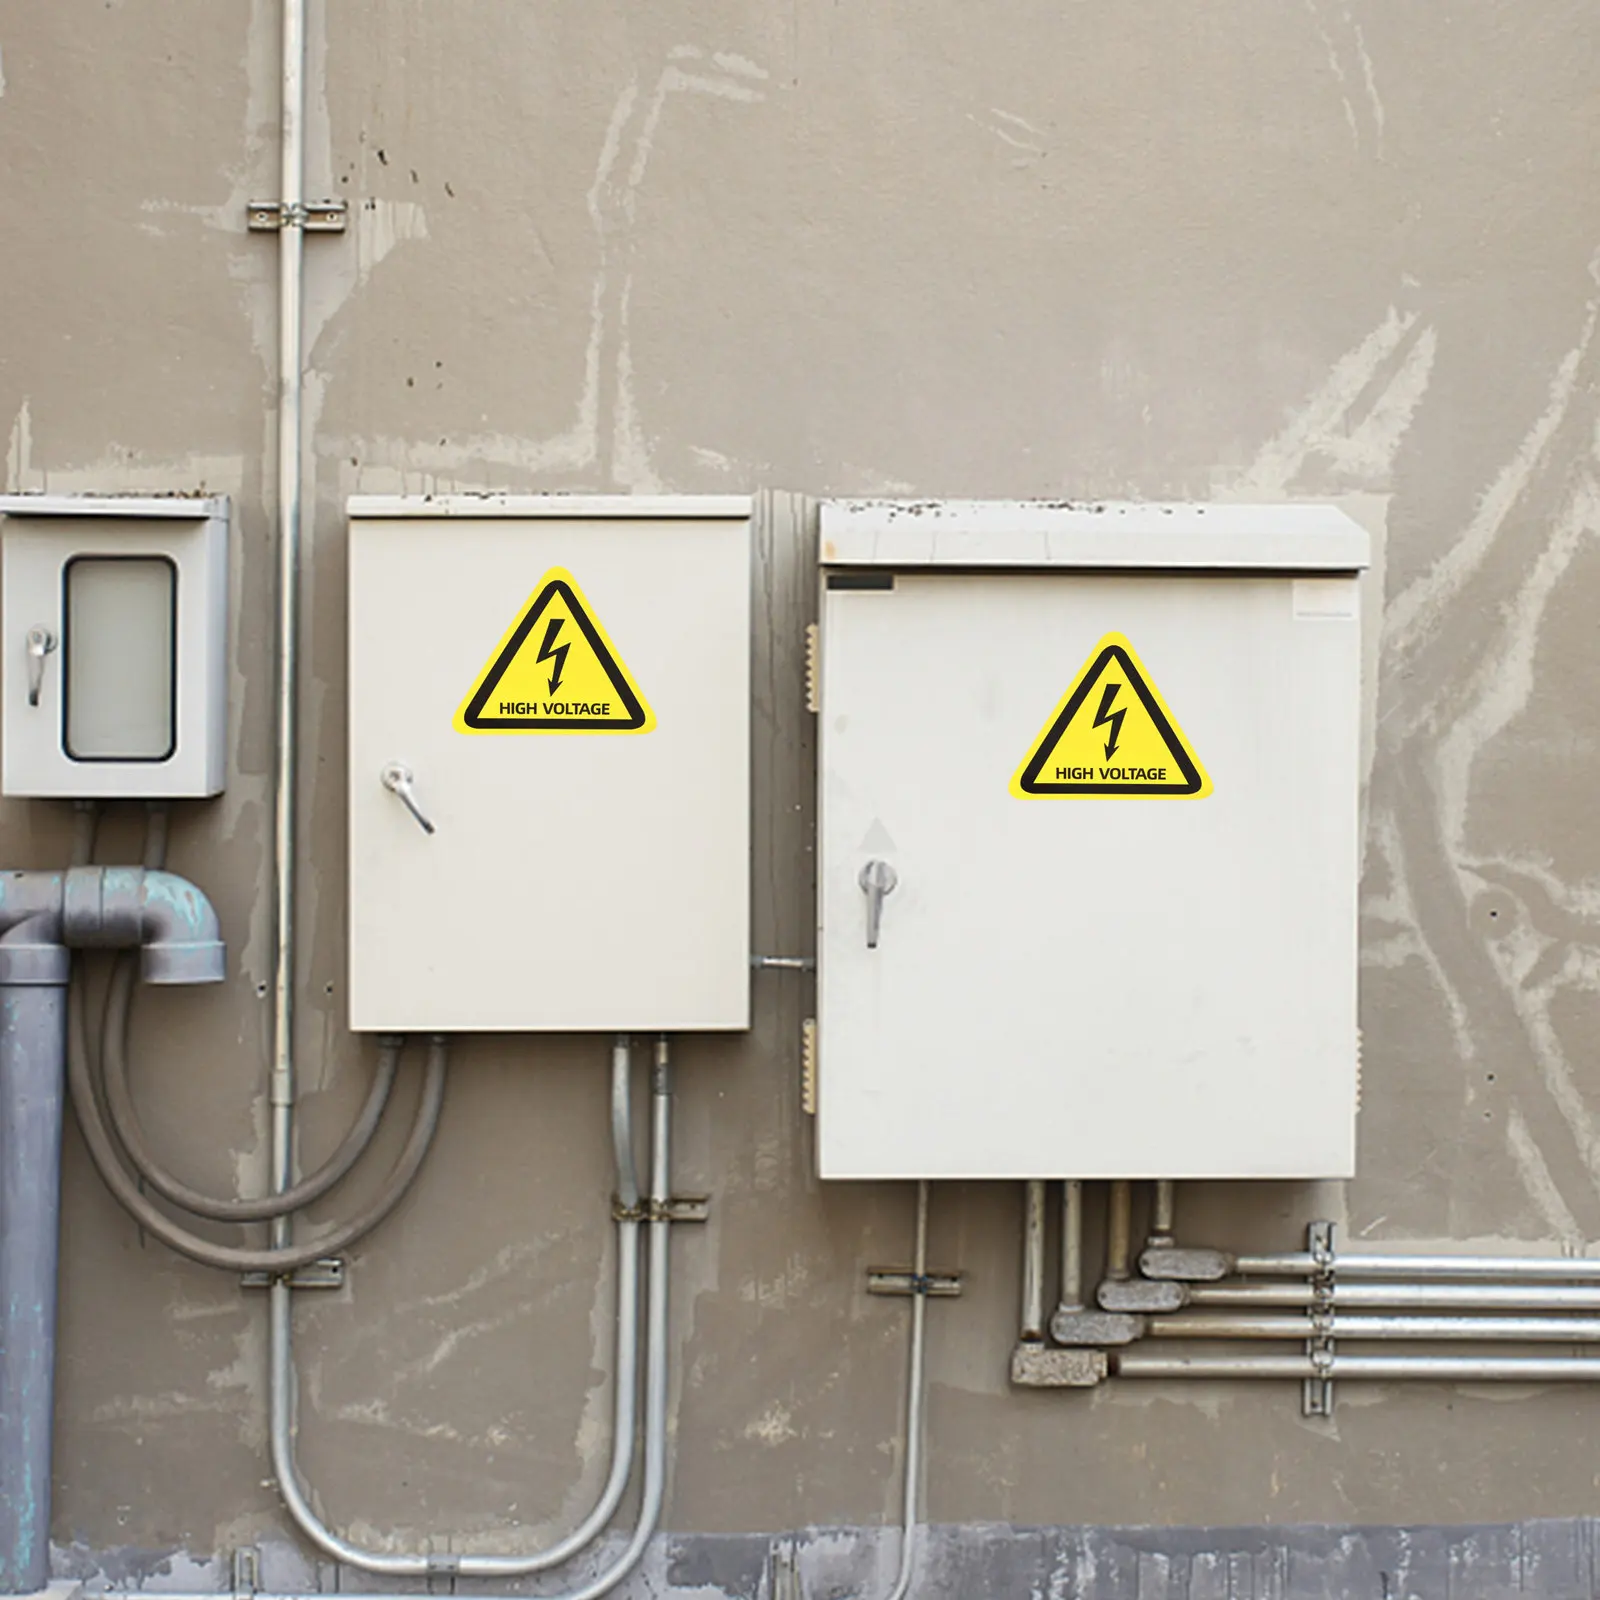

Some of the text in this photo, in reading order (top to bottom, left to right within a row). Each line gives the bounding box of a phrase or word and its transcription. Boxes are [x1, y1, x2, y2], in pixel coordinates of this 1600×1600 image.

[499, 702, 610, 715] HIGH VOLTAGE
[1056, 767, 1166, 780] HIGH VOLTAGE
